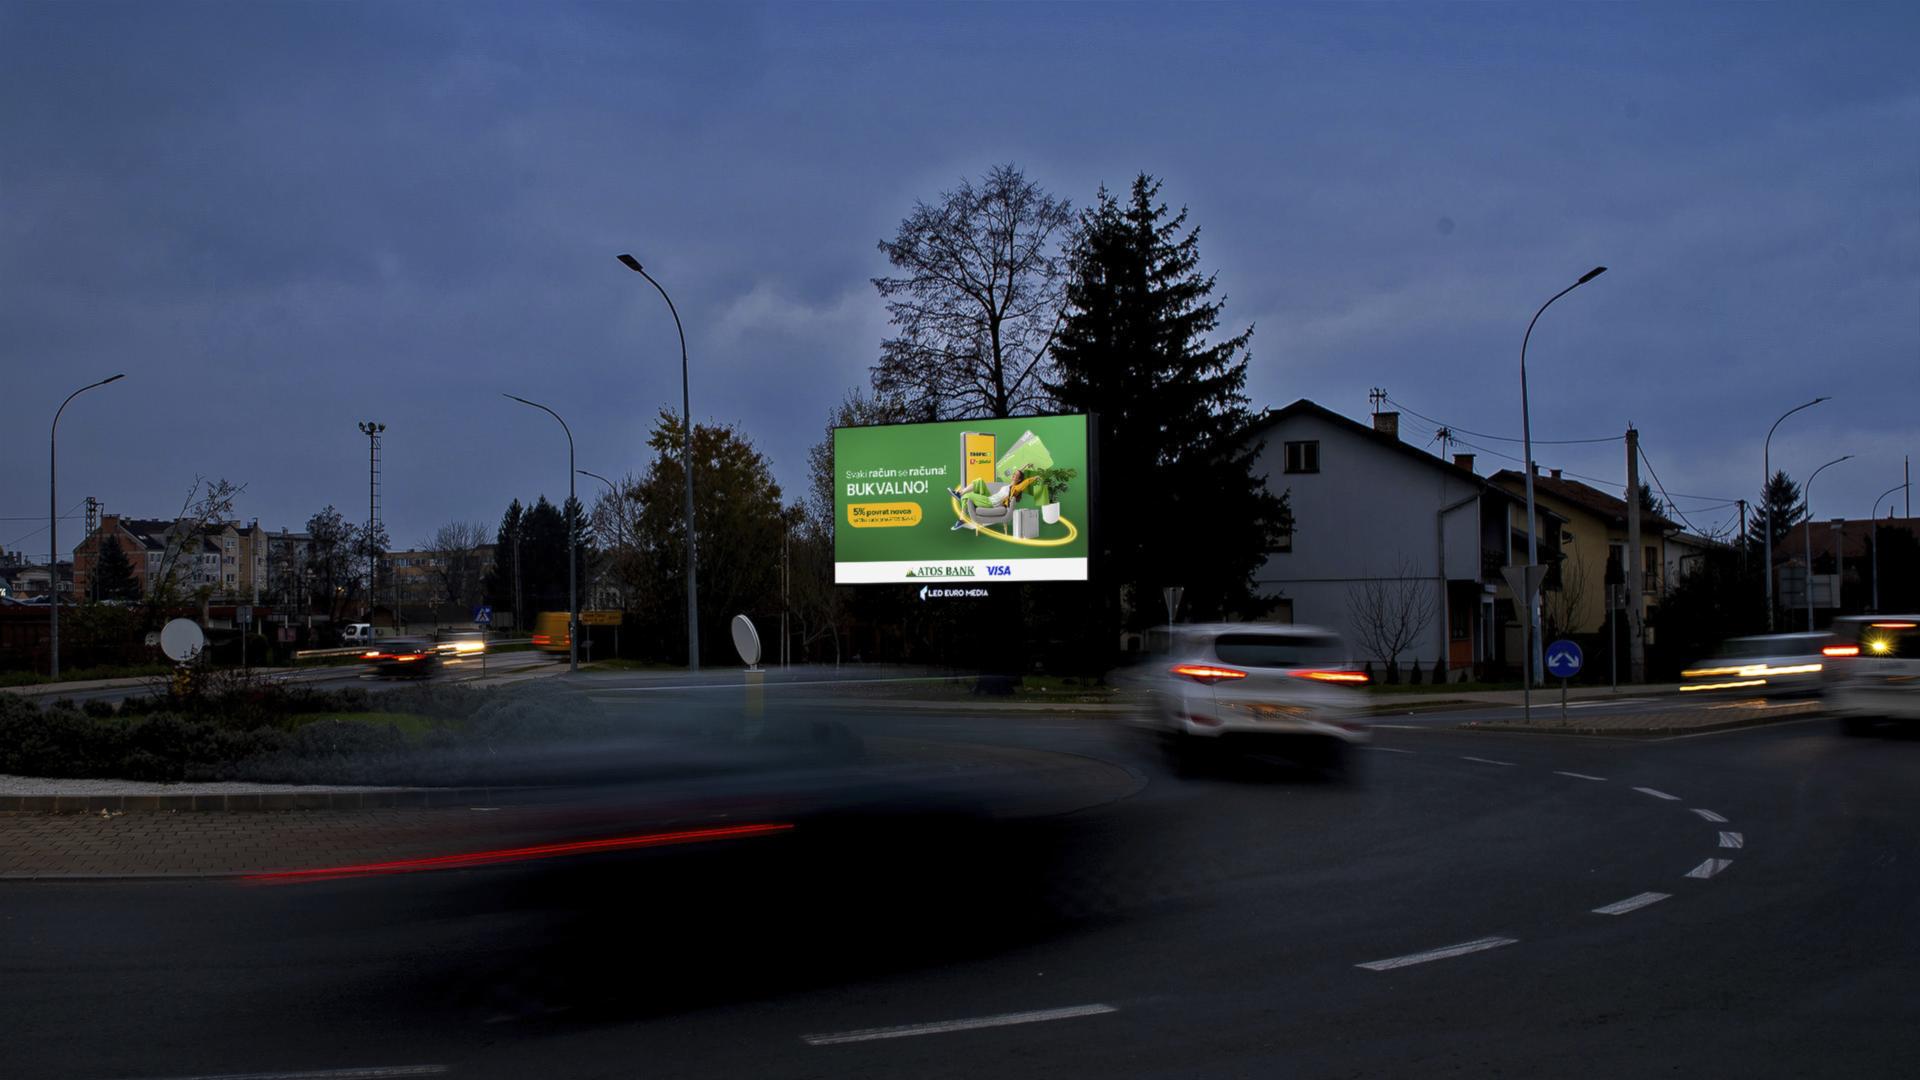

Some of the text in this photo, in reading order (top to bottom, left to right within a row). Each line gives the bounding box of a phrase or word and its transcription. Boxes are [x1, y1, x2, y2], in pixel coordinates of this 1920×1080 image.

[846, 465, 947, 479] Svaki račun se računa!
[847, 480, 929, 496] BUKVALNO!
[853, 507, 866, 516] 5%
[866, 508, 890, 517] povrat
[917, 566, 975, 576] ATOS BANK
[986, 565, 1011, 576] VISA
[928, 589, 989, 597] LED EURO MEDIA
